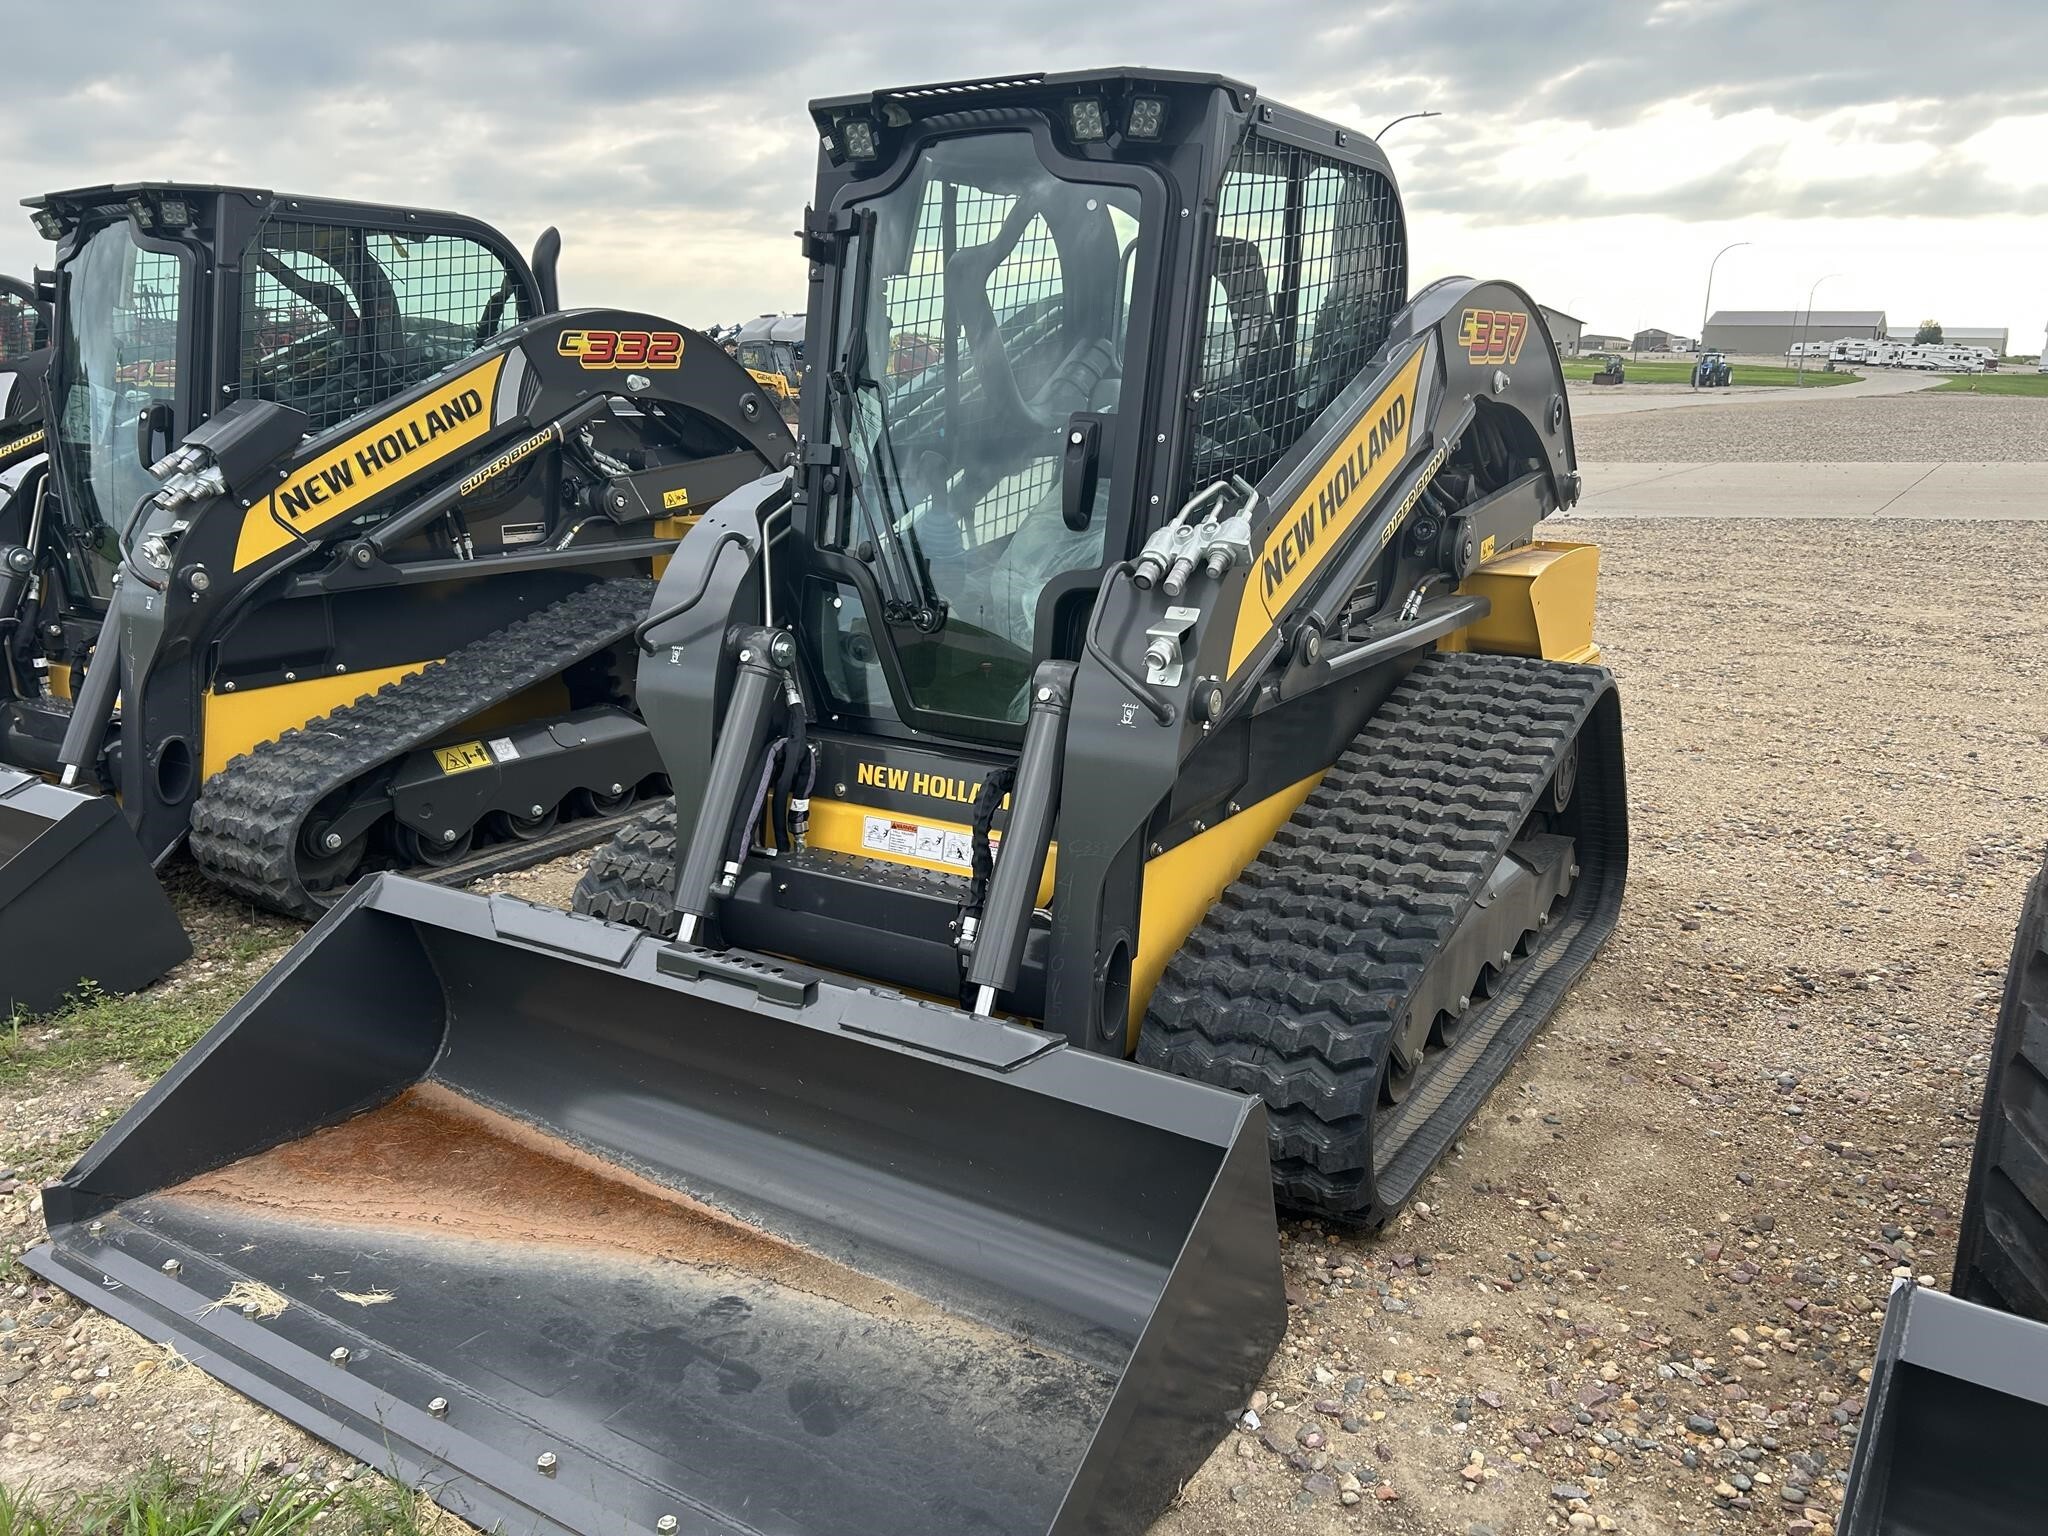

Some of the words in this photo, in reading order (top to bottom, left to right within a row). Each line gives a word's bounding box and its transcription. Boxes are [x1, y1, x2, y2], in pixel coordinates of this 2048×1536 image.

[558, 330, 684, 368] C332
[1459, 309, 1527, 363] C337
[279, 458, 354, 520] NEW
[354, 388, 484, 478] HOLLAND
[461, 456, 509, 495] SUPER
[510, 429, 551, 462] BOOM
[1263, 502, 1315, 599] NEW
[1319, 393, 1406, 529] HOLLAND
[1382, 490, 1415, 548] SUPER
[1416, 448, 1446, 495] BOOM
[857, 762, 909, 792] NEW
